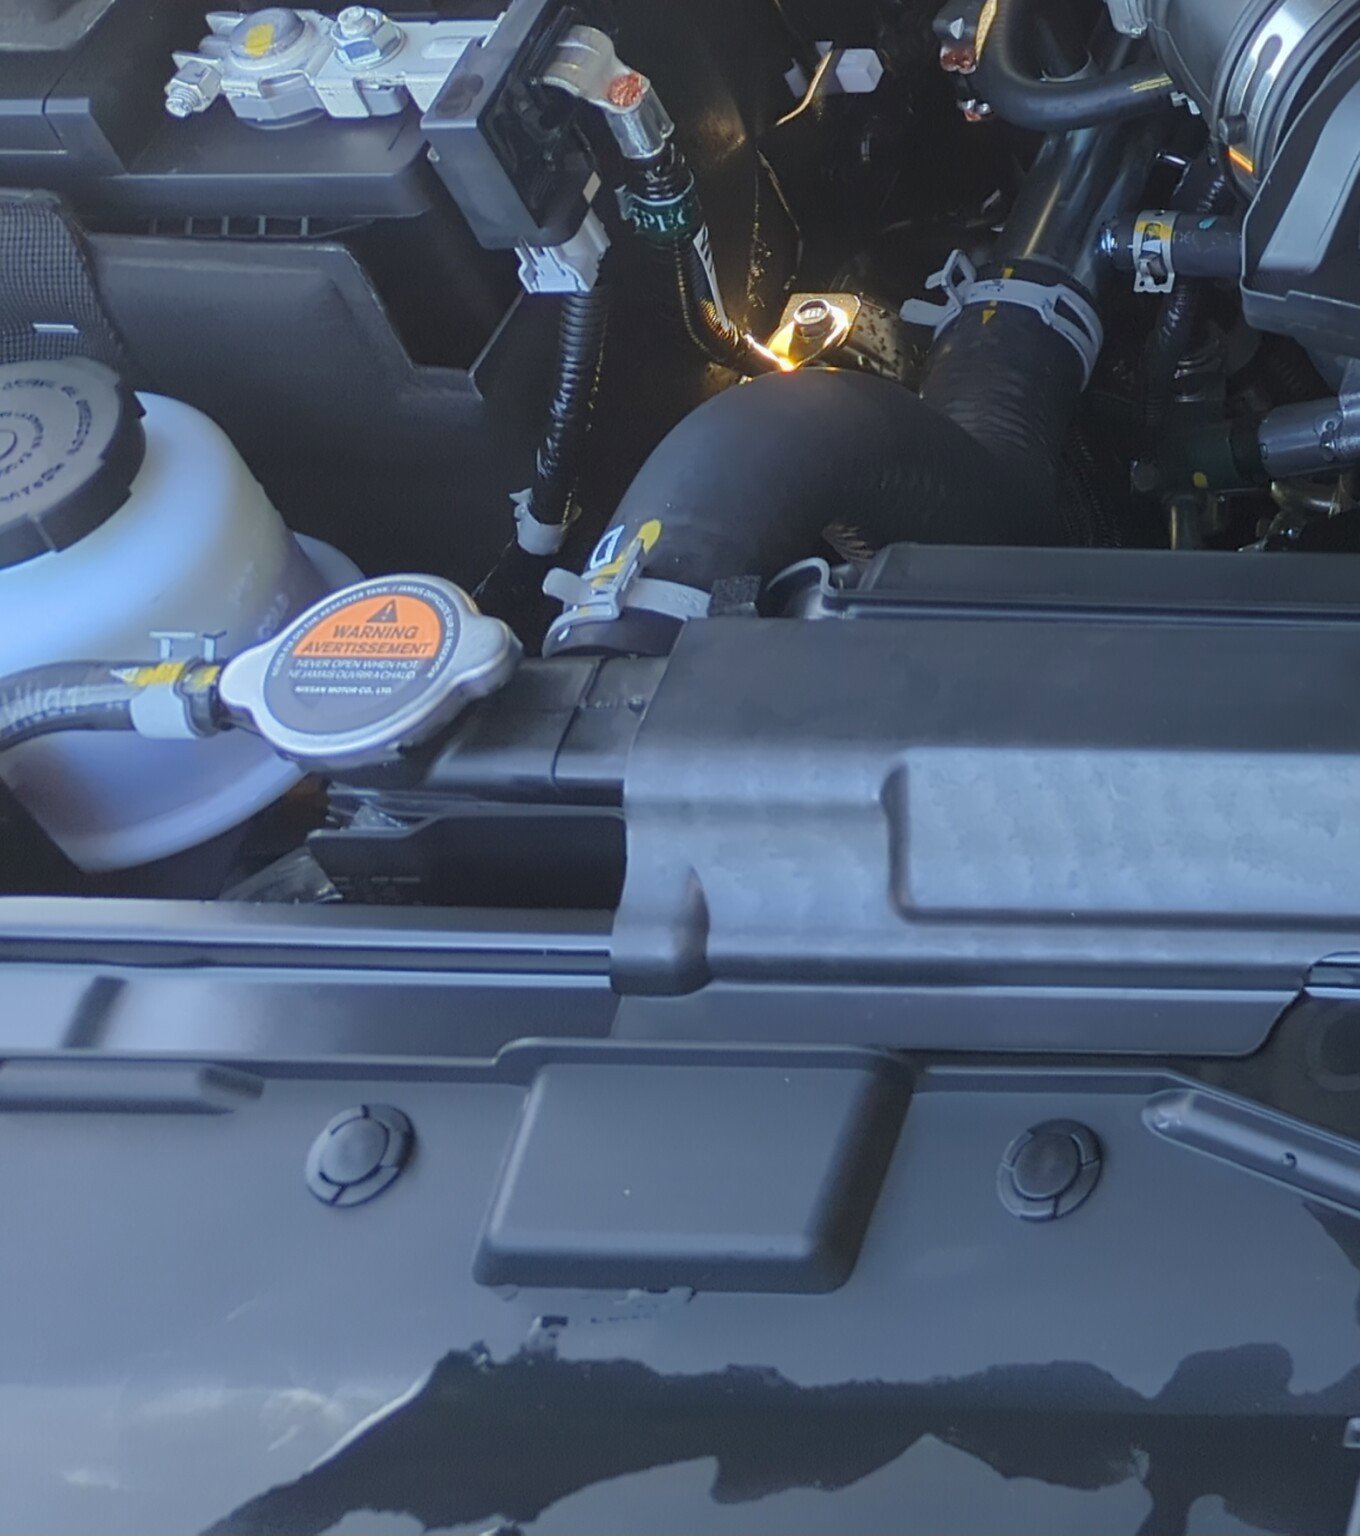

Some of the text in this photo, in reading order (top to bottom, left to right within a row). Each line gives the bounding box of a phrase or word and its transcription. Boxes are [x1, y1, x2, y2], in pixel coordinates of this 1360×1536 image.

[333, 625, 419, 639] WARNING
[302, 641, 433, 654] AVERTISSEMENT
[296, 660, 329, 668] NEVER
[331, 660, 362, 668] OPEN
[363, 660, 395, 669] WHEN
[302, 670, 335, 679] JAMAIS
